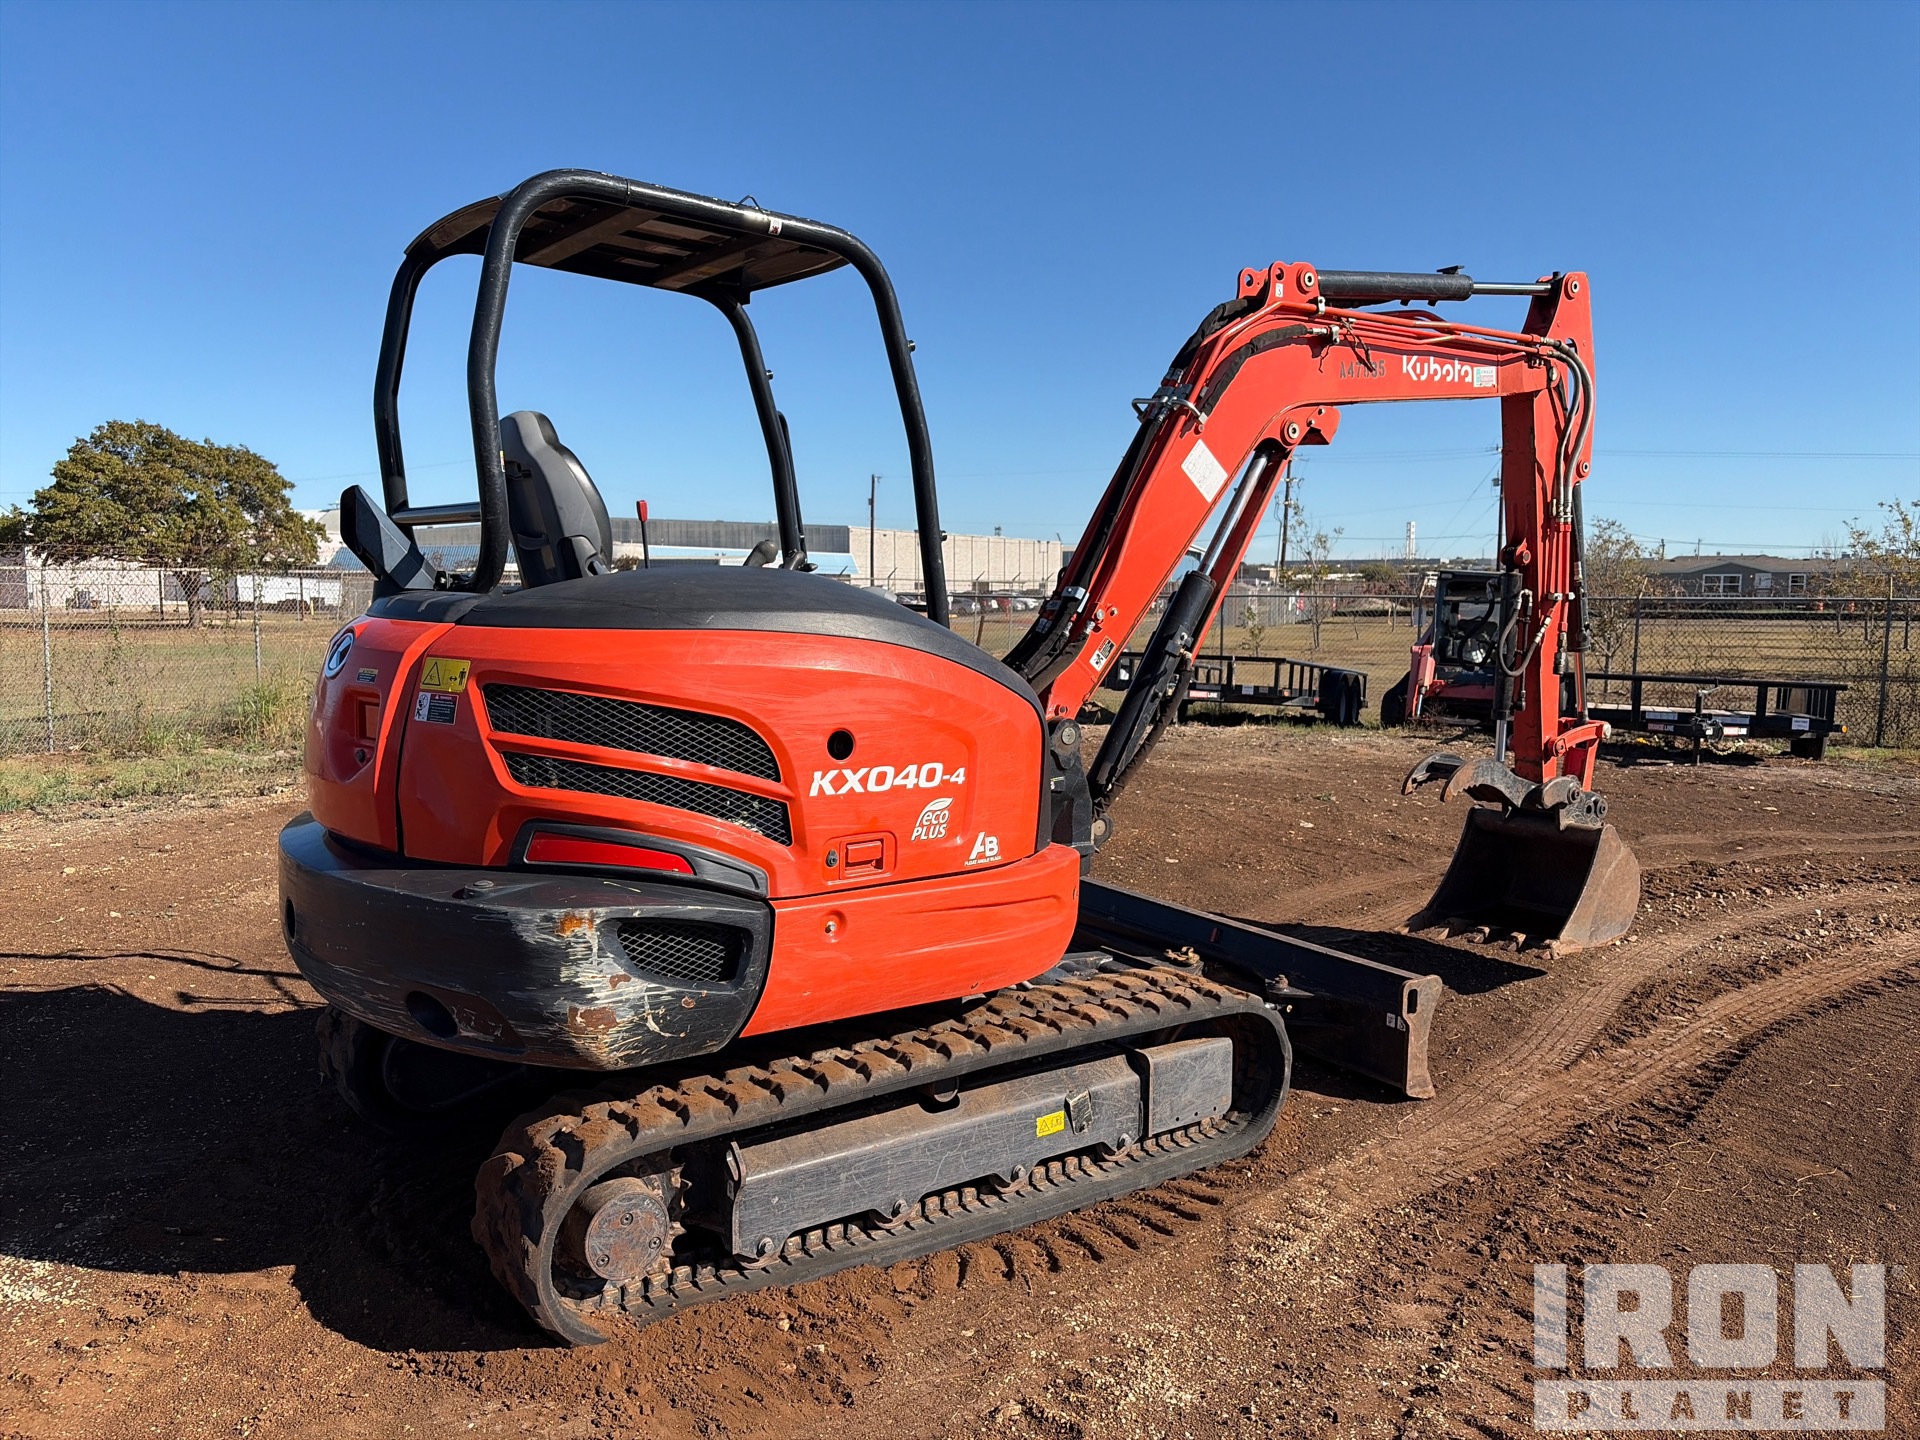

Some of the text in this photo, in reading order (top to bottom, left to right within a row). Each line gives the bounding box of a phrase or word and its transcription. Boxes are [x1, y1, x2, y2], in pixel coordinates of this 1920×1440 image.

[1402, 355, 1472, 383] Kubota
[809, 762, 965, 797] KX040-4
[923, 809, 949, 825] eco
[911, 824, 947, 841] PLUS
[969, 831, 999, 860] AB
